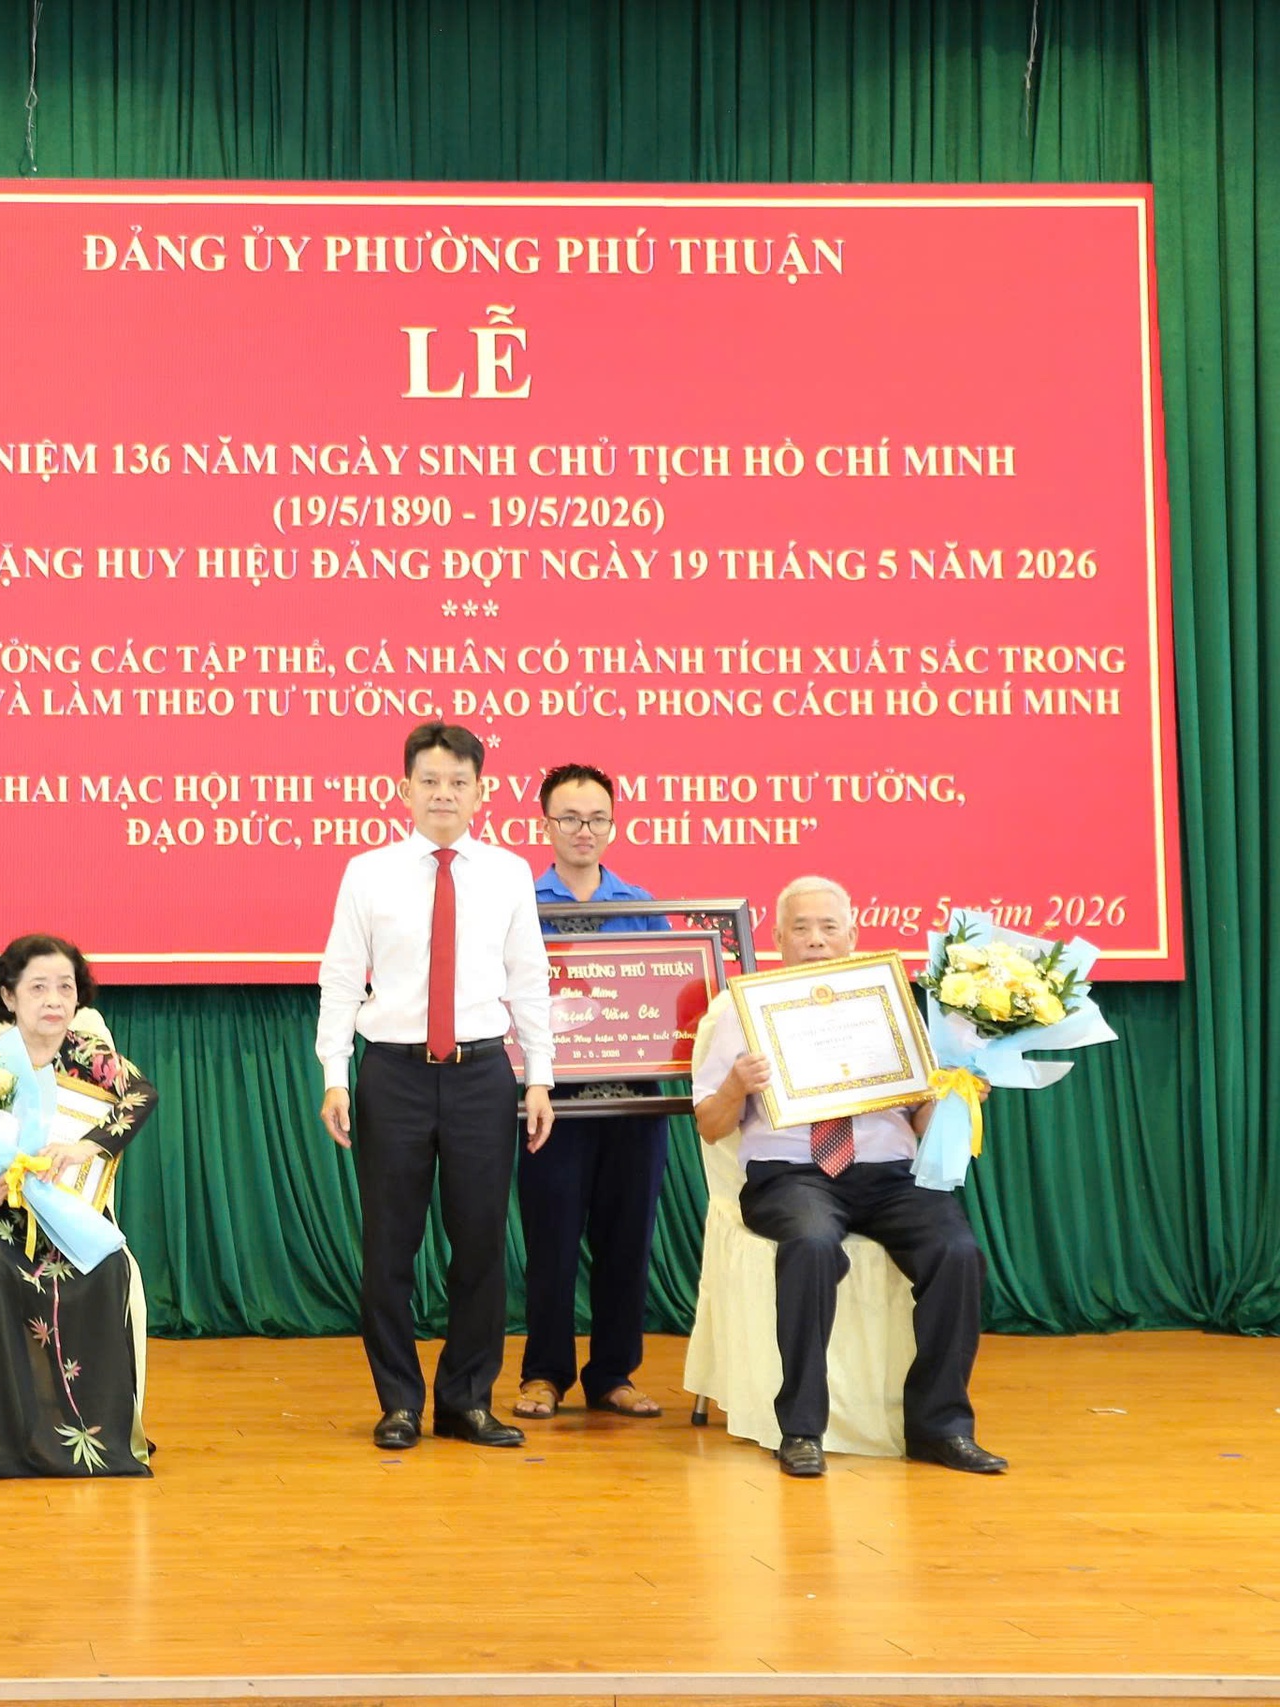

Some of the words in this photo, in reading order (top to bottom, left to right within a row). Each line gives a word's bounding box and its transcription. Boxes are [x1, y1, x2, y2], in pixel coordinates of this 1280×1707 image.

[84, 224, 226, 273] ĐẢNG
[242, 225, 312, 273] ỦY
[325, 226, 540, 274] PHƯỜNG
[556, 228, 656, 274] PHÚ
[670, 232, 844, 285] THUẬN
[400, 304, 532, 399] LỄ
[112, 443, 171, 475] 136
[183, 435, 278, 475] NĂM
[291, 435, 409, 476] NGÀY
[419, 445, 517, 476] SINH
[528, 436, 617, 476] CHỦ
[629, 446, 731, 485] TỊCH
[743, 436, 805, 477] HỒ
[816, 436, 890, 477] CHÍ
[904, 446, 1016, 477] MINH
[273, 495, 452, 534] (19/5/1890
[462, 512, 476, 520] -
[490, 495, 665, 535] 19/5/2026)
[97, 547, 186, 580] HUY
[197, 541, 298, 587] HIỆU
[311, 539, 431, 580] ĐẢNG
[441, 546, 530, 588] ĐỢT
[541, 539, 658, 581] NGÀY
[671, 549, 709, 580] 19
[718, 539, 867, 581] THÁNG
[878, 549, 898, 580] 5
[909, 540, 1004, 580] NĂM
[1017, 548, 1097, 580] 2026
[90, 638, 167, 674] CÁC
[175, 639, 247, 681] TẬP
[253, 636, 336, 681] THỂ,
[345, 638, 396, 674] CÁ
[406, 637, 506, 674] NHÂN
[517, 638, 570, 675] CÓ
[578, 638, 705, 675] THÀNH
[714, 638, 802, 675] TÍCH
[812, 638, 911, 675] XUẤT
[920, 638, 989, 675] SẮC
[998, 646, 1126, 675] TRONG
[43, 680, 122, 716] LÀM
[132, 687, 235, 716] THEO
[243, 682, 297, 717] TƯ
[303, 680, 443, 720] TƯỞNG,
[452, 688, 531, 724] ĐẠO
[539, 681, 627, 720] ĐỨC,
[637, 688, 763, 717] PHONG
[772, 681, 874, 717] CÁCH
[885, 681, 939, 717] HỒ
[947, 681, 1012, 717] CHÍ
[1024, 688, 1120, 716] MINH
[80, 775, 163, 811] MẠC
[174, 771, 241, 811] HỘI
[250, 775, 314, 803] THI
[324, 775, 405, 810] “HỌ
[656, 775, 758, 804] THEO
[765, 770, 817, 804] TƯ
[824, 768, 966, 808] TƯỞNG,
[126, 817, 205, 854] ĐẠO
[214, 810, 303, 850] ĐỨC,
[312, 817, 413, 846] PHON
[469, 811, 552, 846] ÁCH
[625, 810, 691, 846] CHÍ
[702, 817, 818, 846] MINH”
[931, 897, 952, 927] 5
[1045, 896, 1127, 927] 2026
